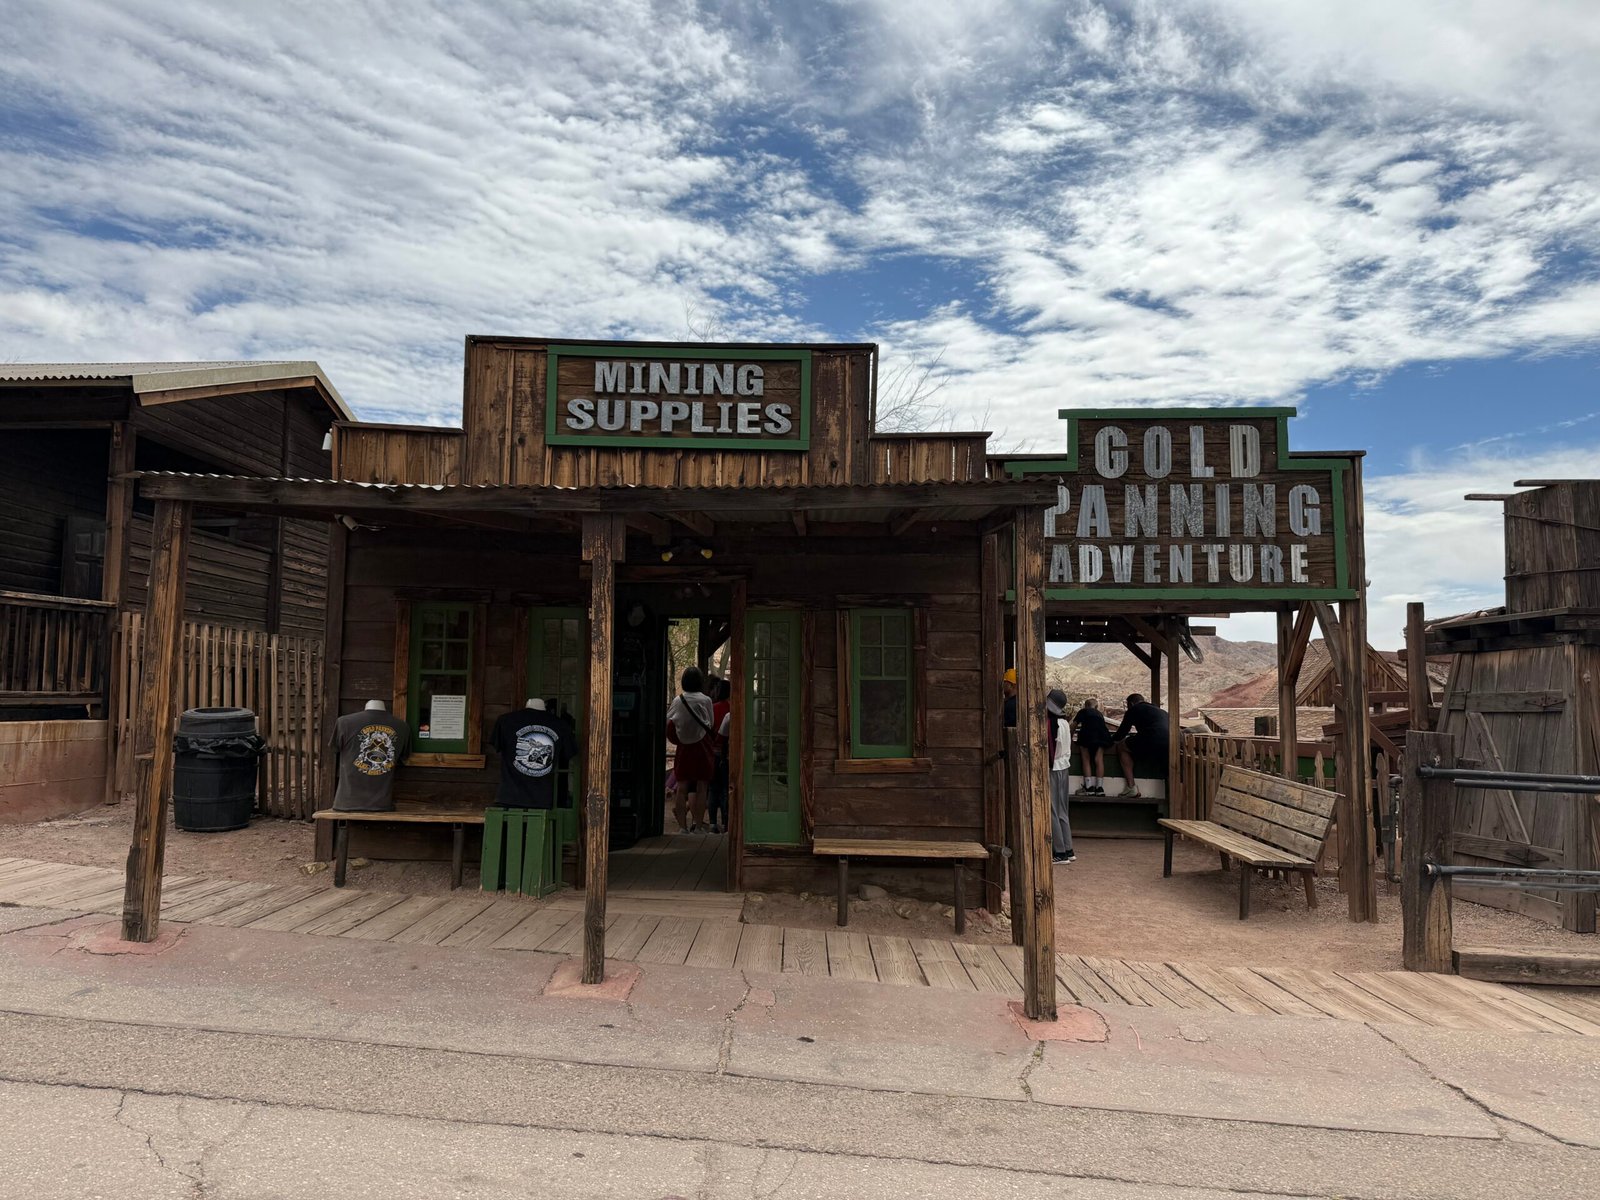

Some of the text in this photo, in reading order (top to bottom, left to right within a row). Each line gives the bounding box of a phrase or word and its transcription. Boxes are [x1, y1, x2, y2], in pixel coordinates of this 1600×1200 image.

[594, 361, 765, 396] MINING
[566, 398, 792, 434] SUPPLIES
[1095, 425, 1261, 479] GOLD
[1044, 484, 1321, 537] PANNING
[1049, 544, 1309, 583] ADVENTURE
